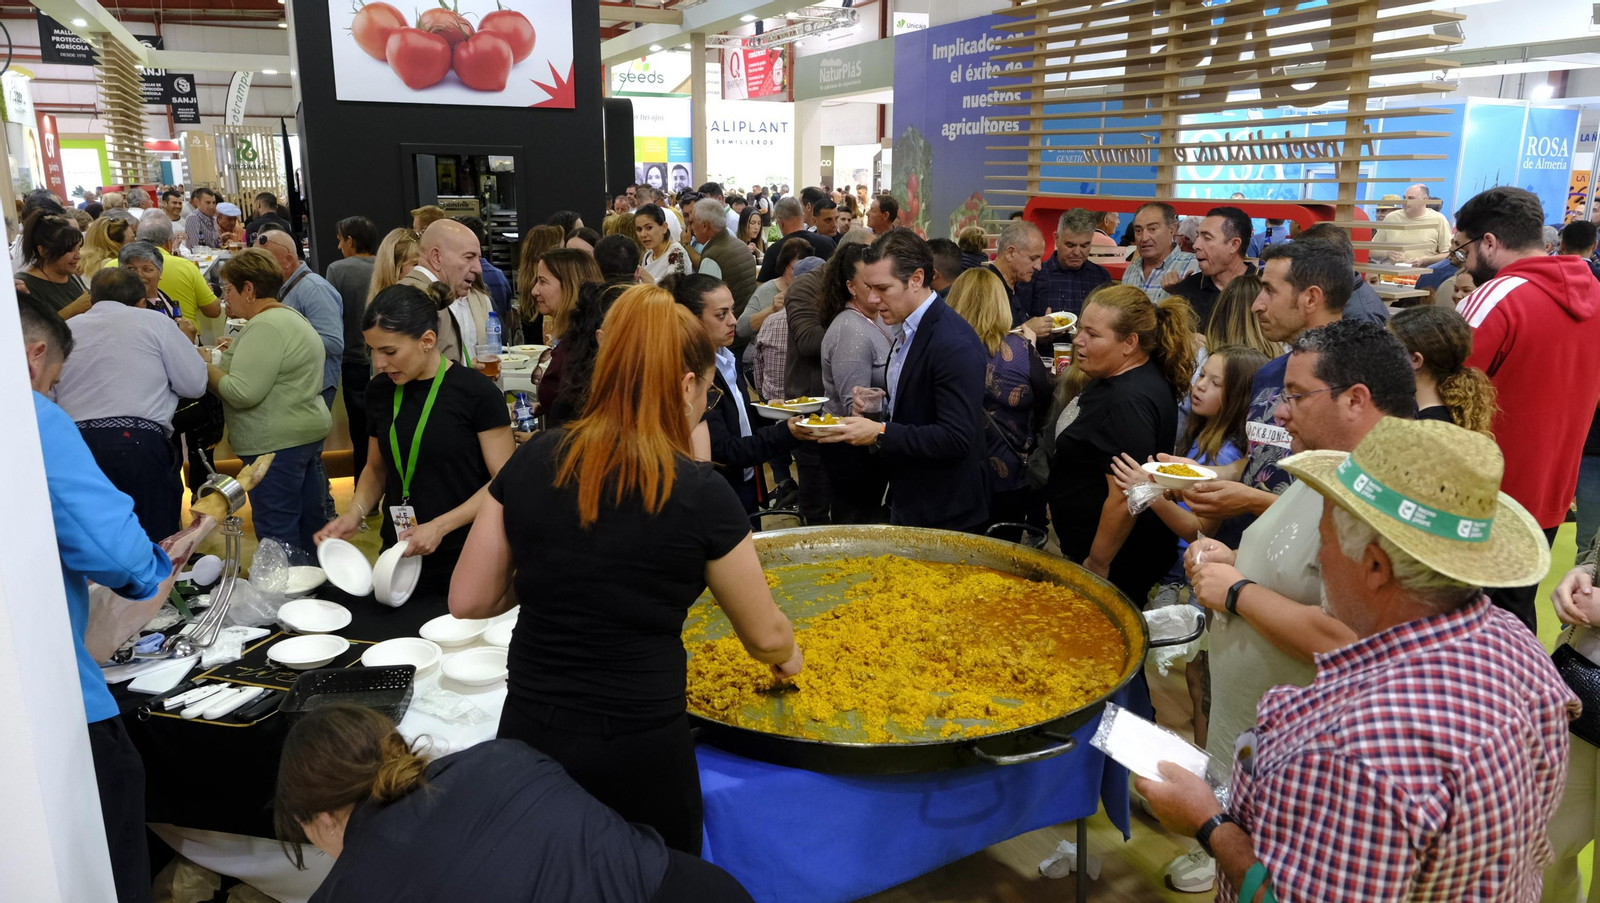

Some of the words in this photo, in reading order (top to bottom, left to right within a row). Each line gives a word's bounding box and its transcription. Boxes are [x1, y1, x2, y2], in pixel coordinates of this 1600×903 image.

[55, 43, 89, 51] AGRÍCOLA
[933, 33, 1002, 63] Implicados
[950, 64, 962, 83] el
[965, 62, 1001, 82] éxito
[963, 90, 1021, 108] nuestros
[942, 116, 1019, 141] agricultores
[1580, 133, 1590, 142] LA
[1525, 136, 1569, 157] ROSA
[1523, 157, 1534, 169] de
[1535, 157, 1568, 170] Almería
